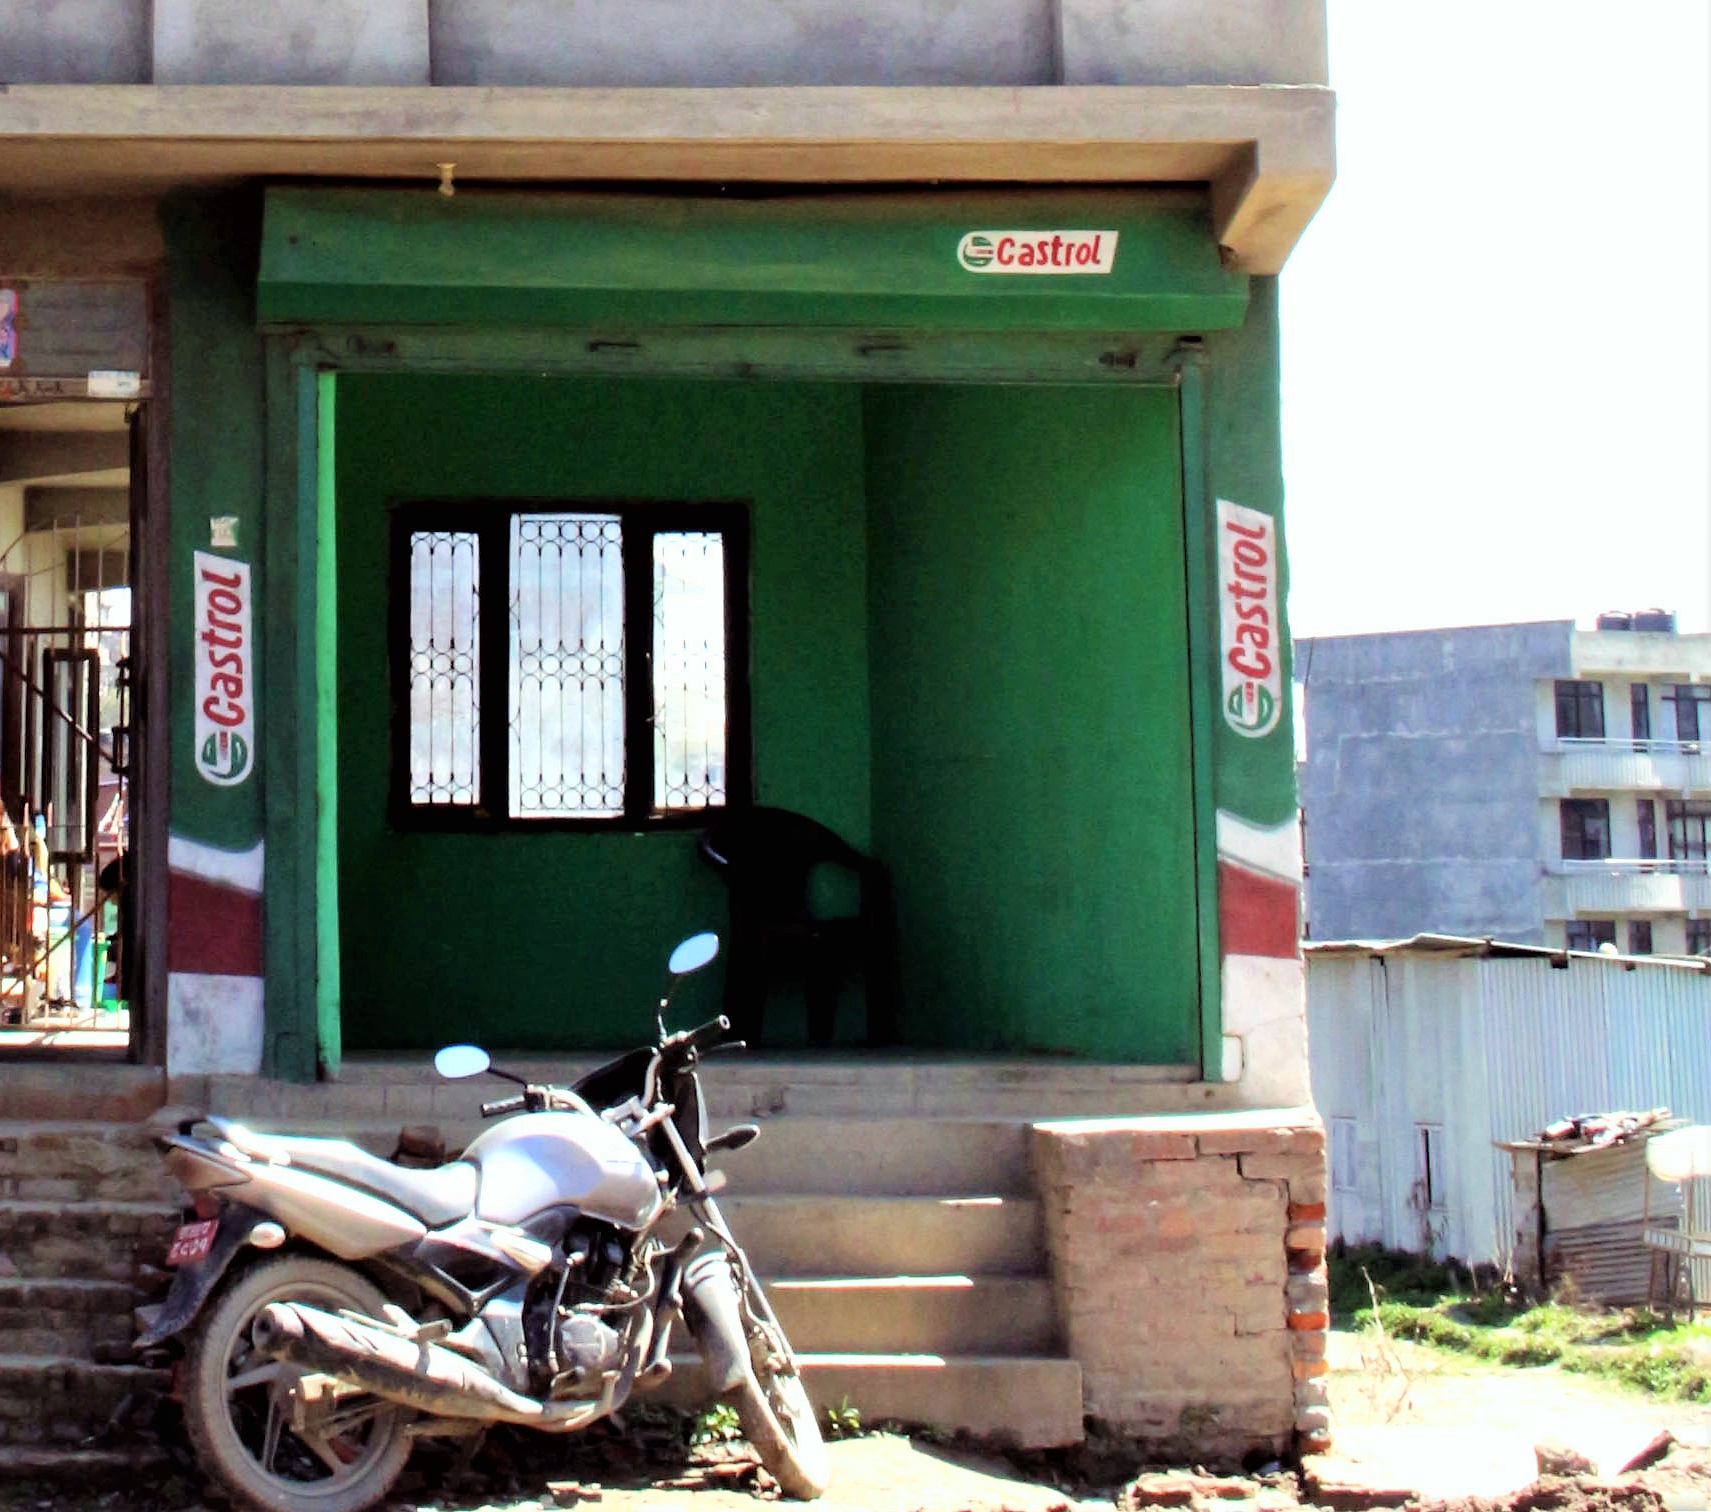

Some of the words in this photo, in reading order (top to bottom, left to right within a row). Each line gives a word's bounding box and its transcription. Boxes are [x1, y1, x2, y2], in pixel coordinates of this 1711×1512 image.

[997, 235, 1101, 266] Castrol
[201, 568, 246, 727] Castrol
[1226, 521, 1272, 679] Castrol
